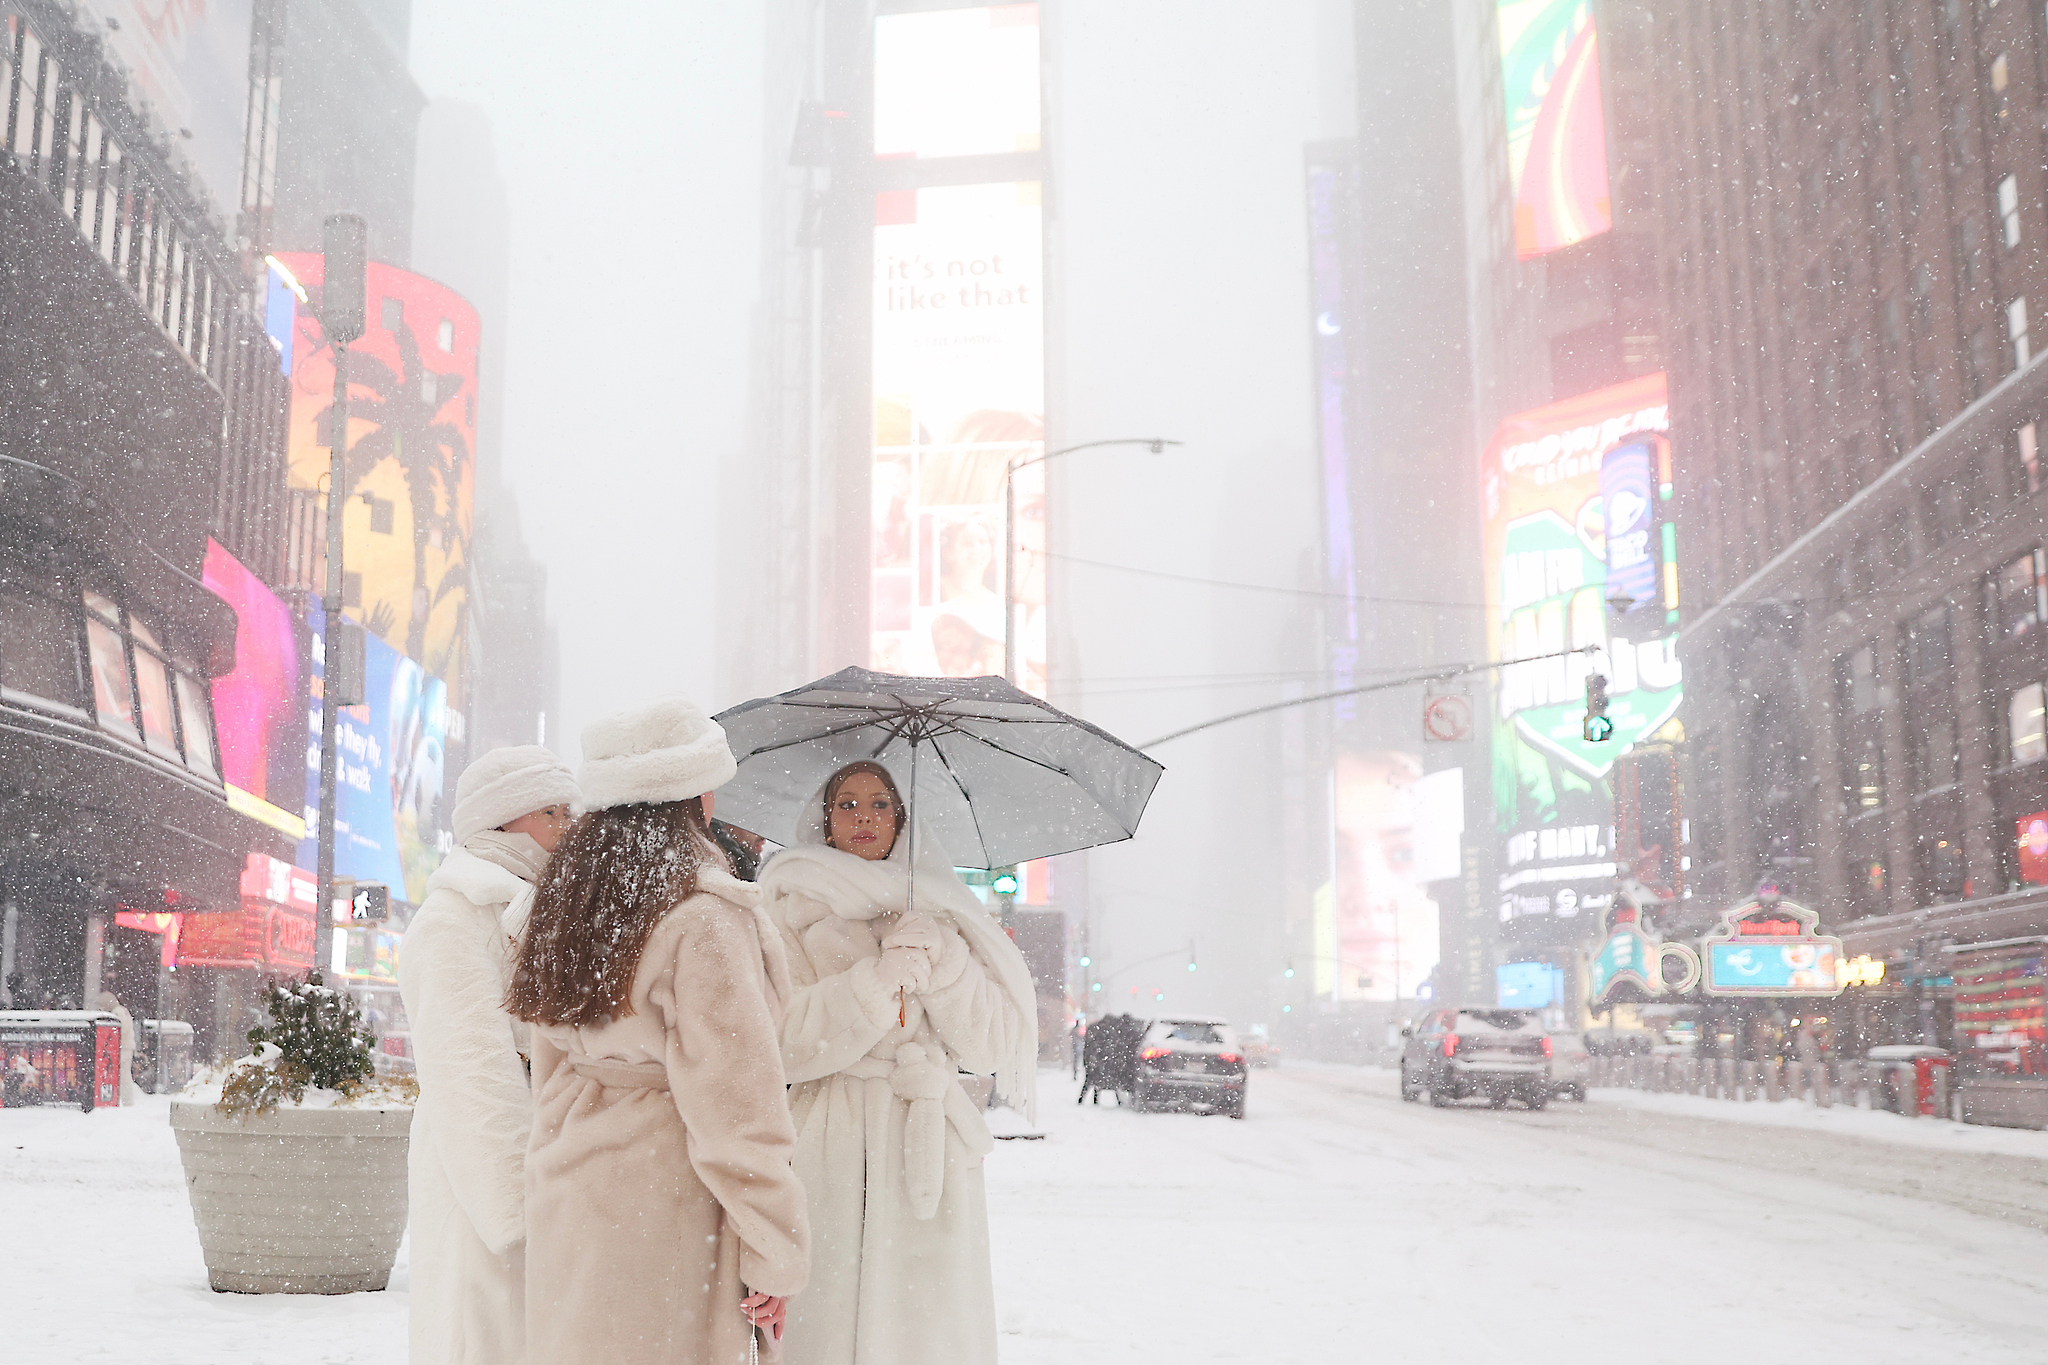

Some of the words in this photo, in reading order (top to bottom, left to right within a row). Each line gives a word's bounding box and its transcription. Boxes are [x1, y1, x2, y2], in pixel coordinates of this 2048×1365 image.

[888, 254, 935, 280] it's
[947, 254, 1003, 277] not
[888, 285, 947, 311] like
[959, 281, 1029, 307] that
[1534, 450, 1604, 486] REIMAG
[1608, 530, 1648, 552] TACO
[1611, 546, 1649, 570] BELL
[1333, 647, 1358, 720] Roku
[344, 722, 367, 762] they
[336, 756, 346, 782] &
[346, 763, 372, 794] walk
[1539, 824, 1607, 860] MANY,
